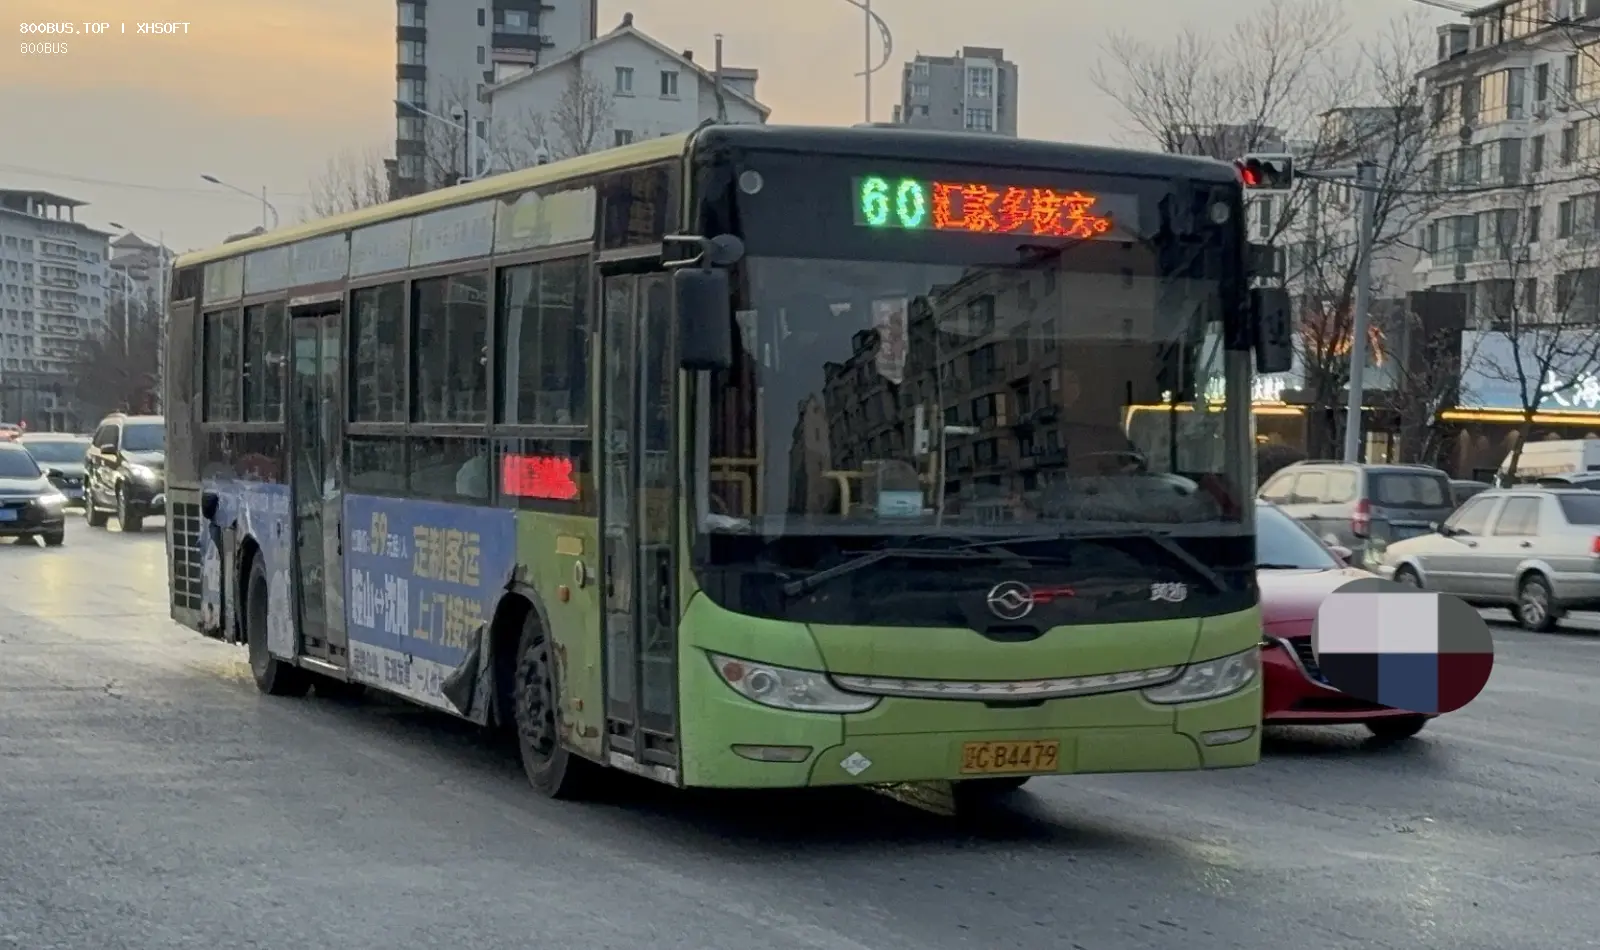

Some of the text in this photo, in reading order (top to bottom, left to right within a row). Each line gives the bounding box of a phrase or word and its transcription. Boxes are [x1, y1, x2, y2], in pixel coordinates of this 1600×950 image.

[862, 176, 926, 228] 60
[412, 524, 480, 587] 定制客运
